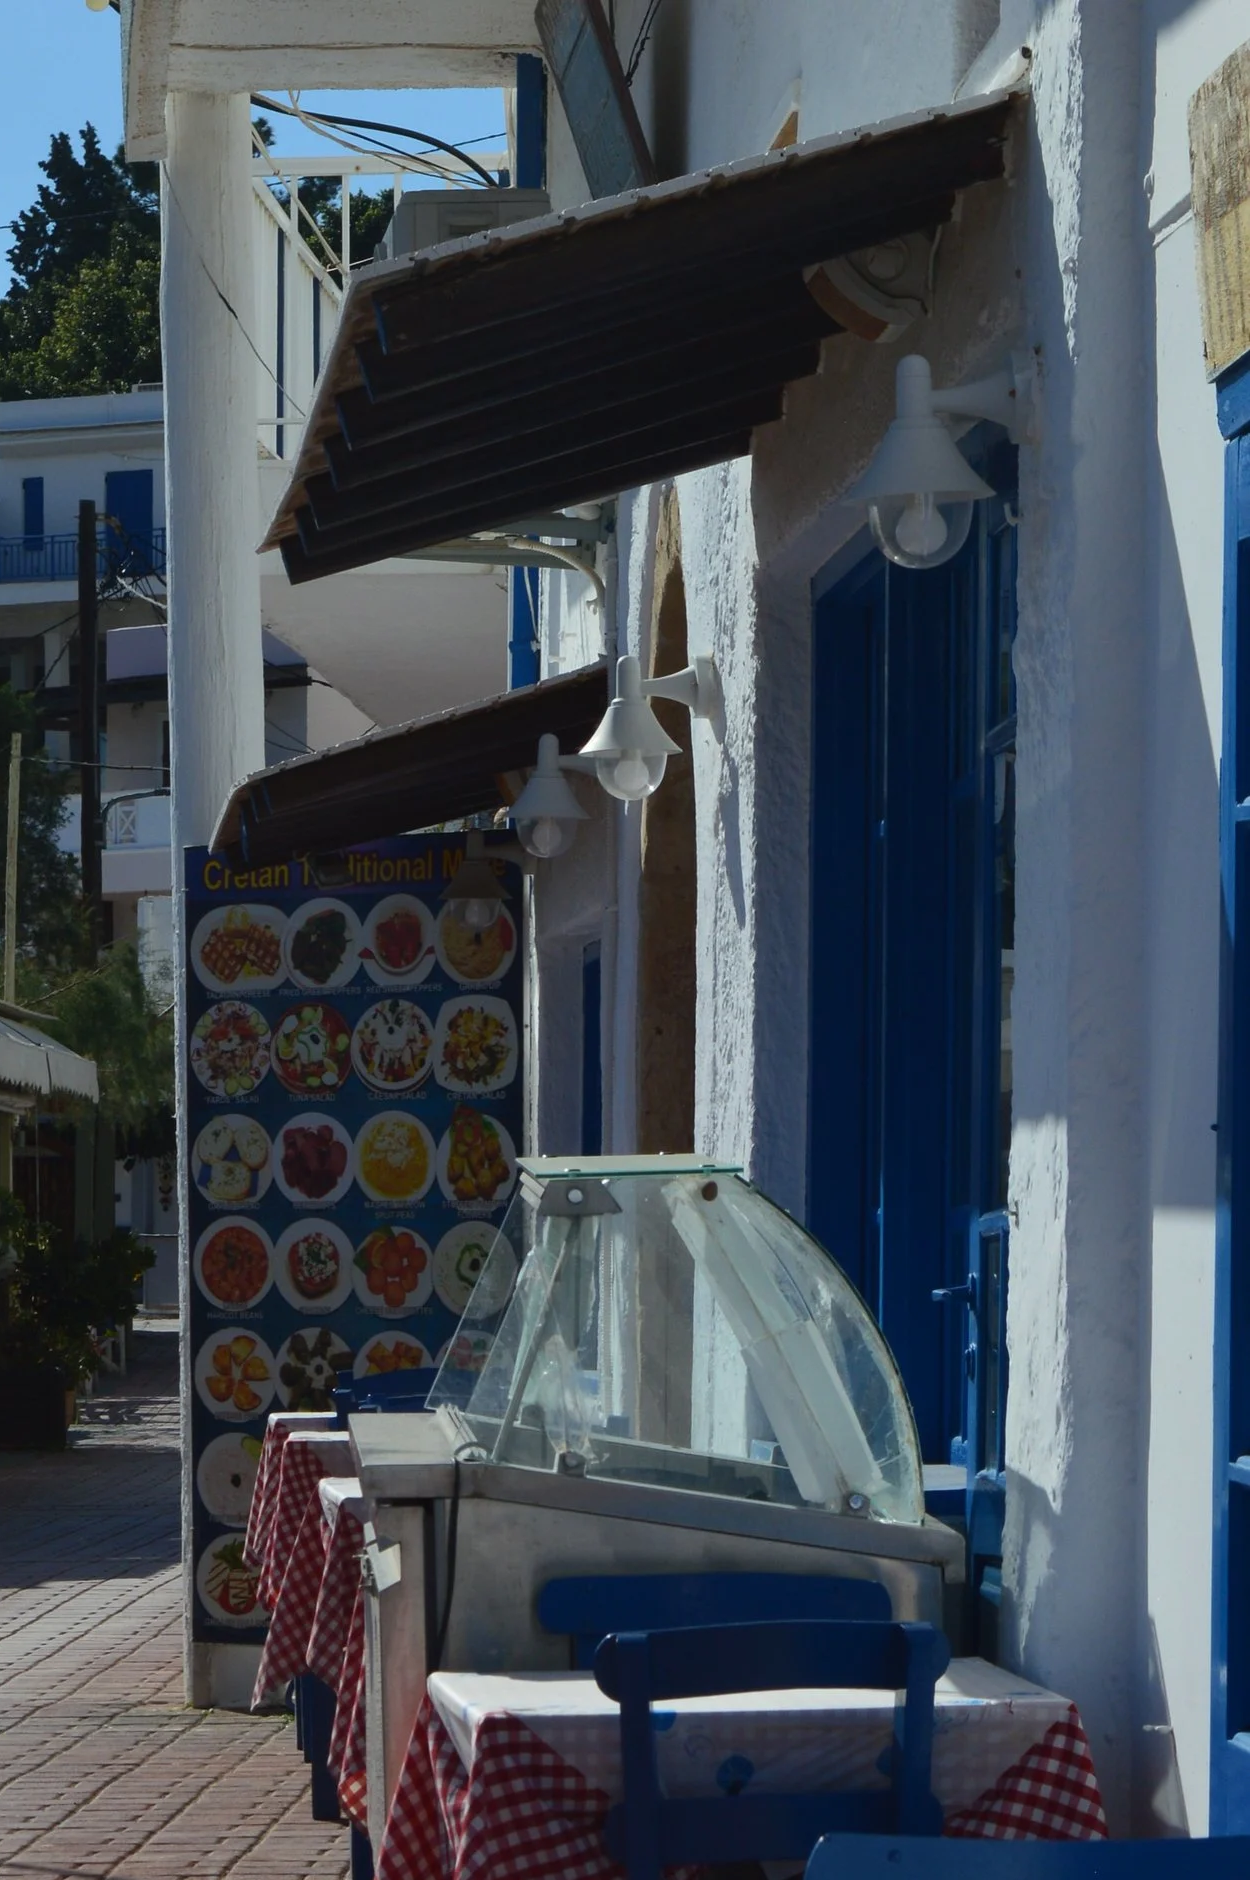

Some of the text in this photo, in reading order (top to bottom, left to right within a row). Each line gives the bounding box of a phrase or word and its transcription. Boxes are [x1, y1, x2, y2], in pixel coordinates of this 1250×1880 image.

[204, 861, 289, 889] Cretan
[442, 848, 506, 879] Me
[288, 1093, 336, 1102] TUNA SALAD
